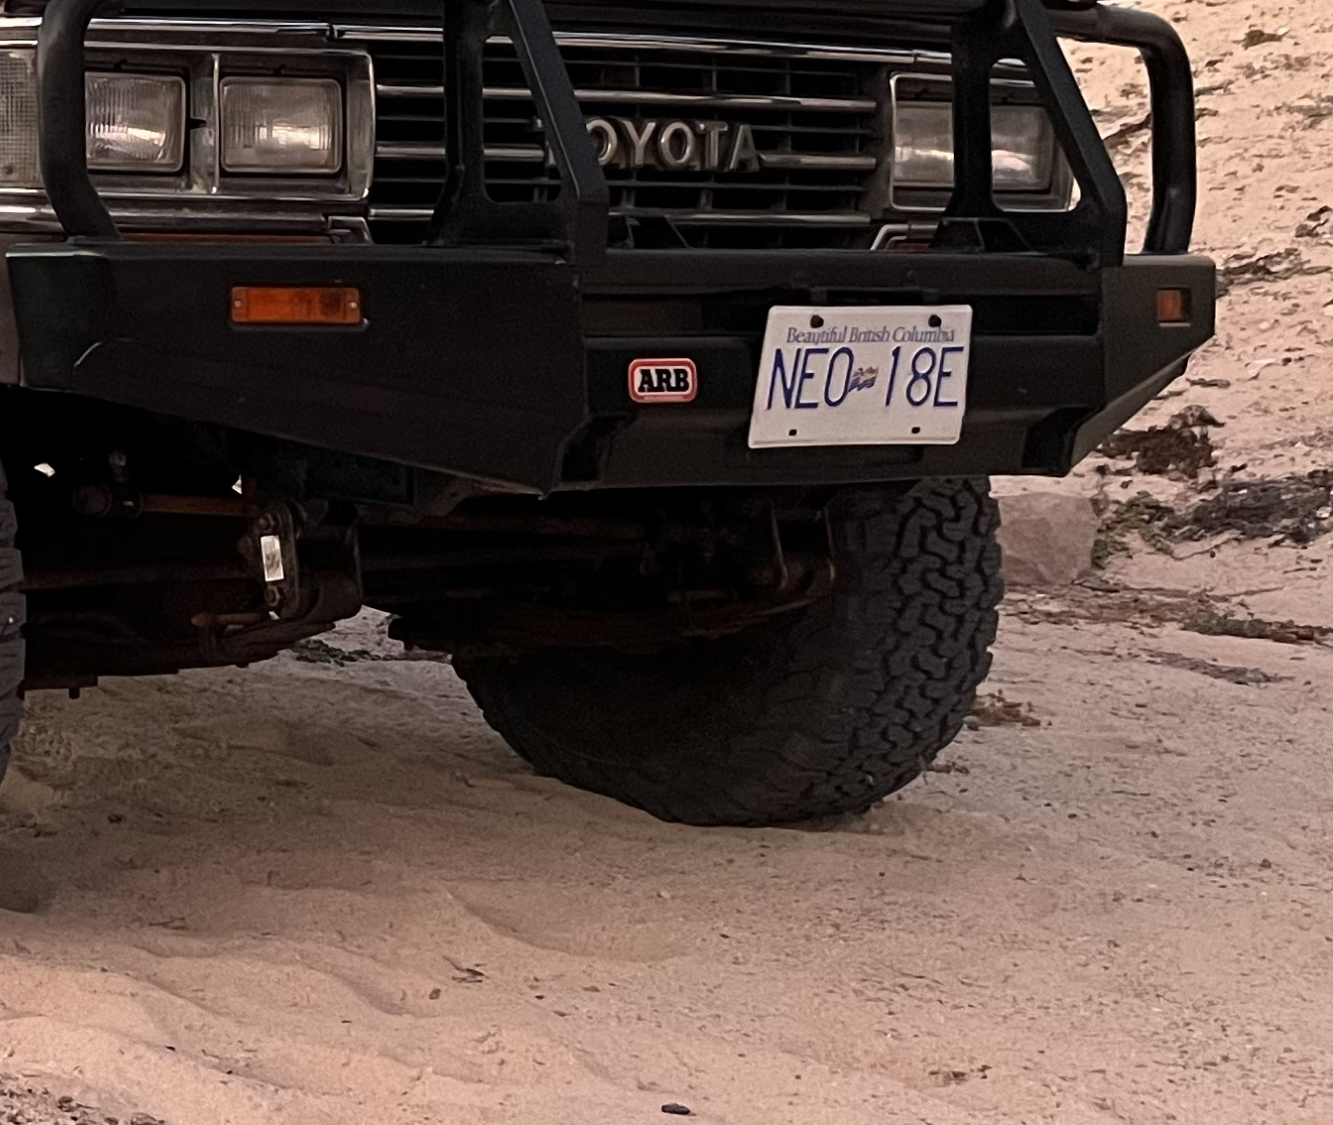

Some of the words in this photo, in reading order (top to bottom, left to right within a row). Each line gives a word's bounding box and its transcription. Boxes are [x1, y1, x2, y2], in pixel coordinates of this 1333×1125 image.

[536, 117, 761, 173] OYOTA
[786, 326, 847, 345] Beautiful
[848, 326, 890, 344] British
[892, 325, 955, 343] Columbia
[638, 368, 690, 393] ARB
[885, 346, 964, 408] 18E
